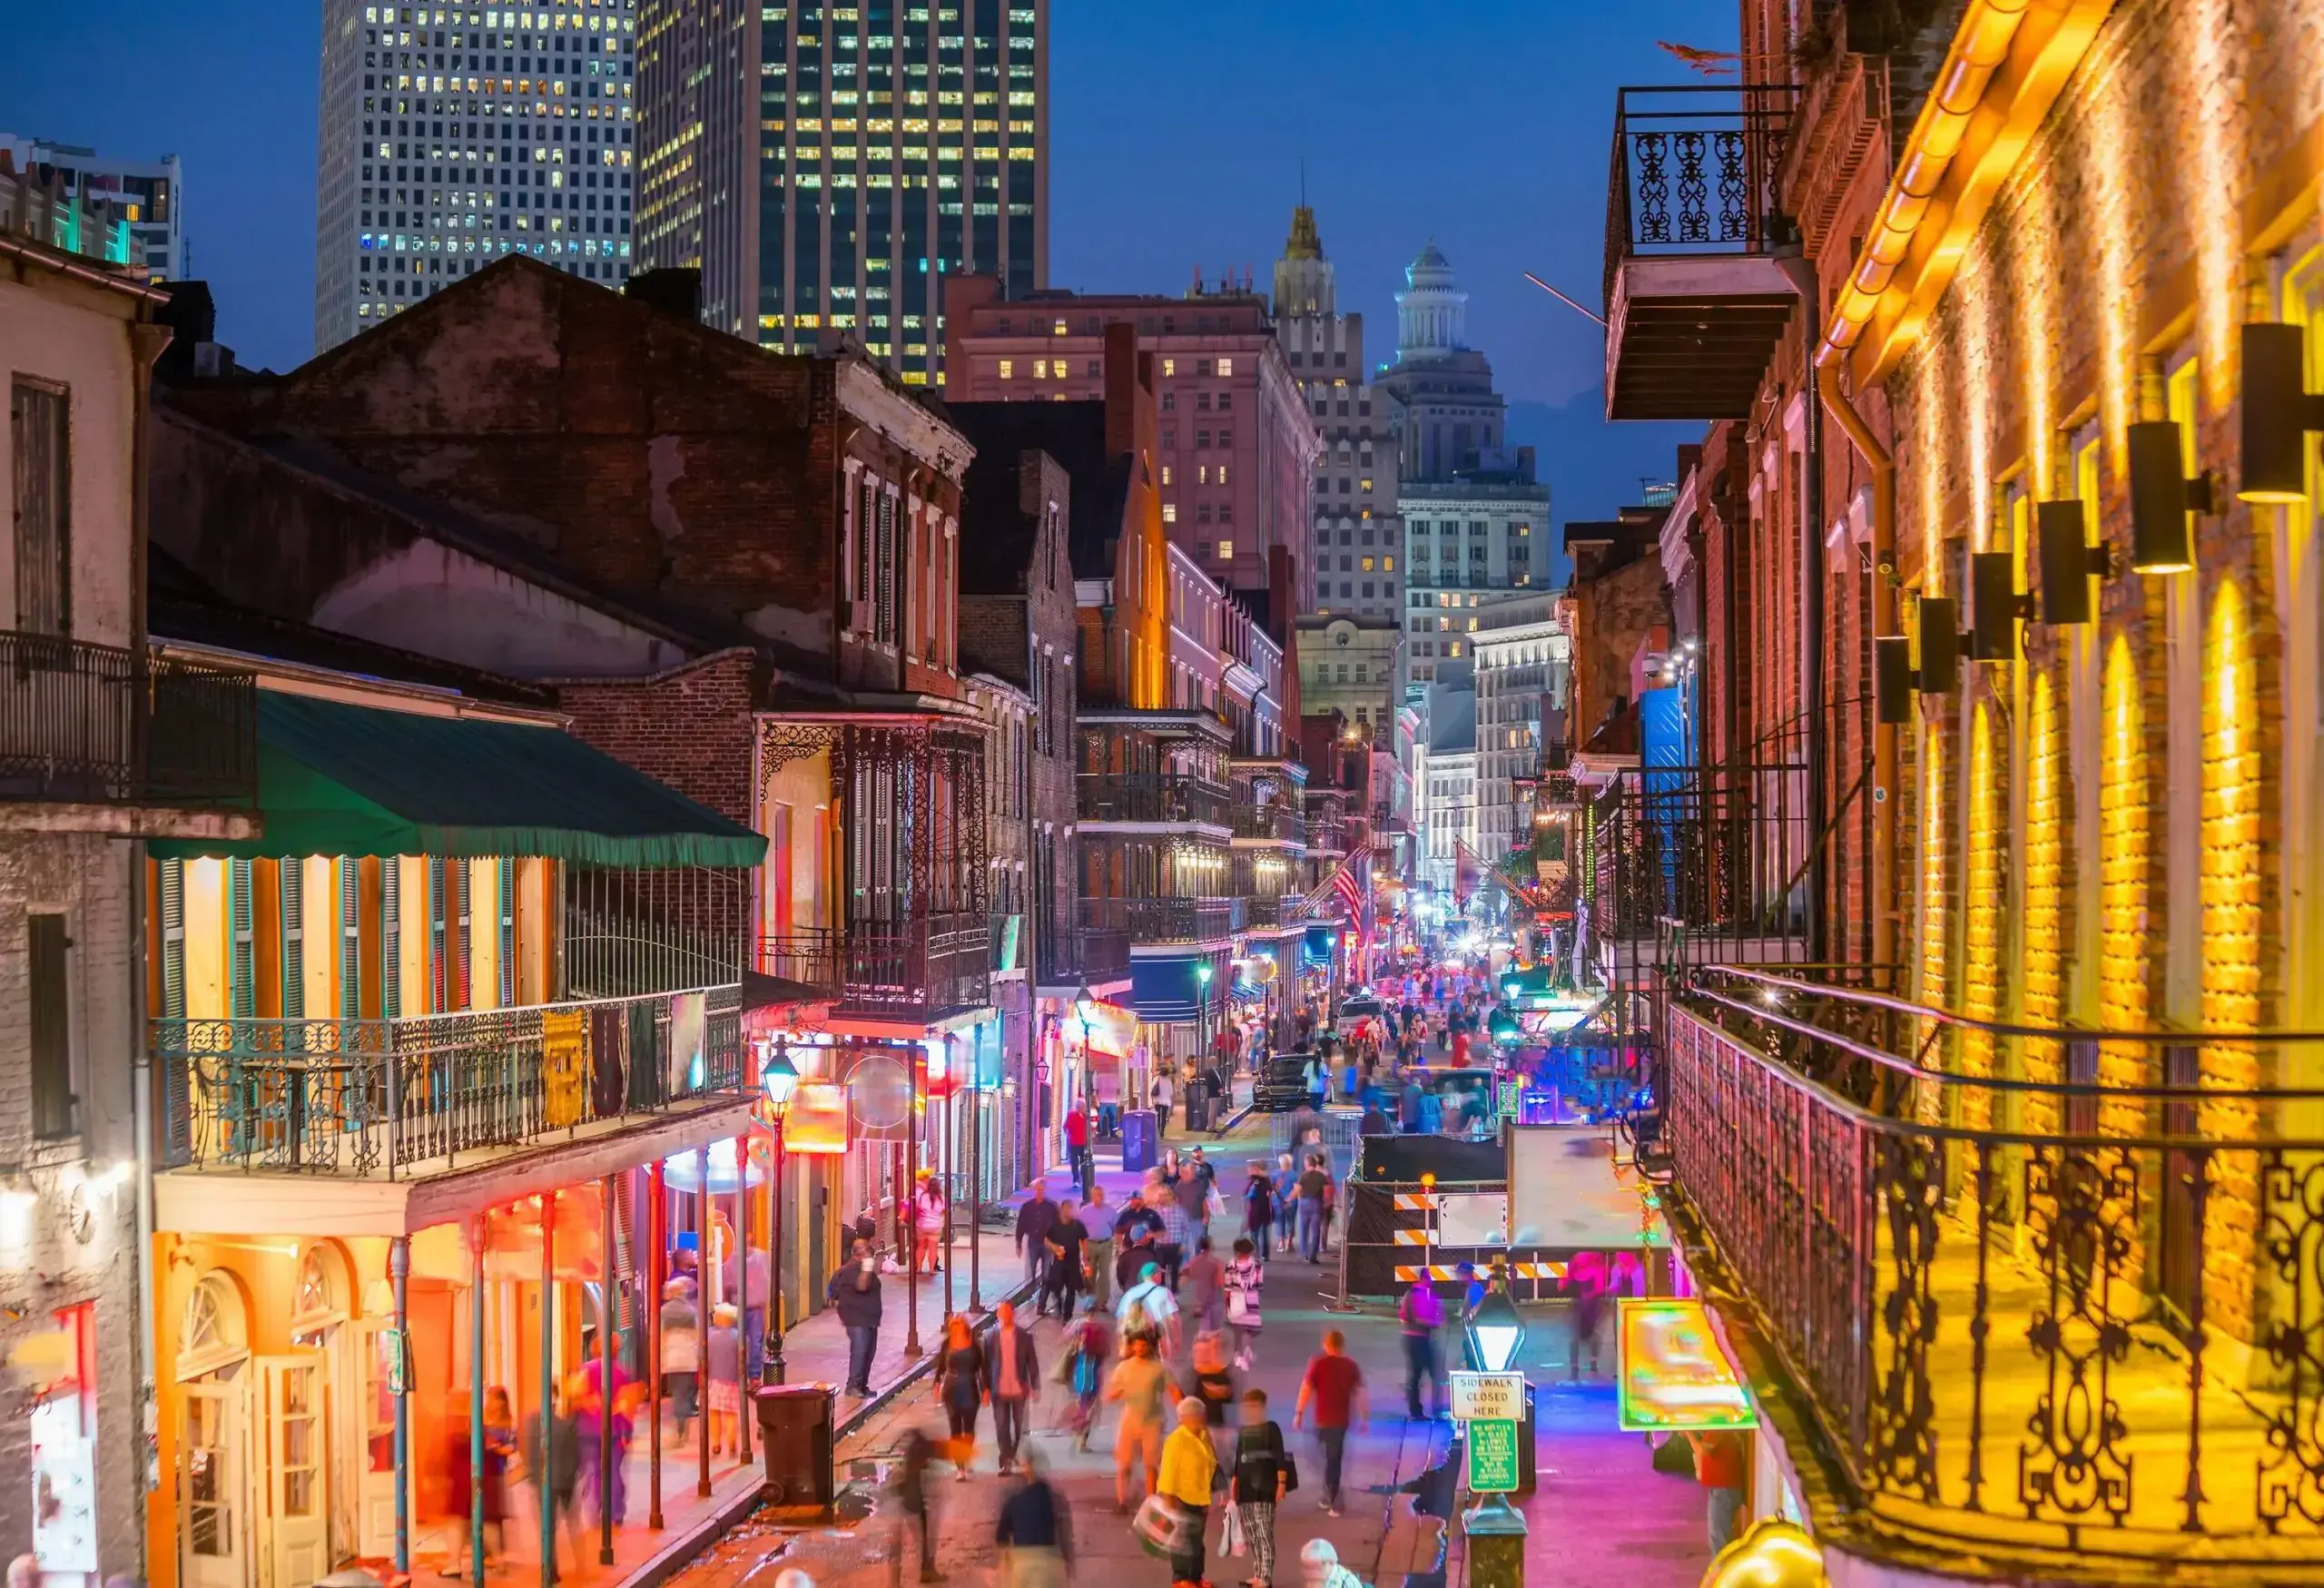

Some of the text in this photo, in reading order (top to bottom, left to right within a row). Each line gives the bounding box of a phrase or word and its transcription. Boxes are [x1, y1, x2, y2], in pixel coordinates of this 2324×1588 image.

[1461, 1378, 1513, 1387] SIDEWALK
[1467, 1392, 1508, 1402] CLOSED
[1474, 1406, 1502, 1416] HERE
